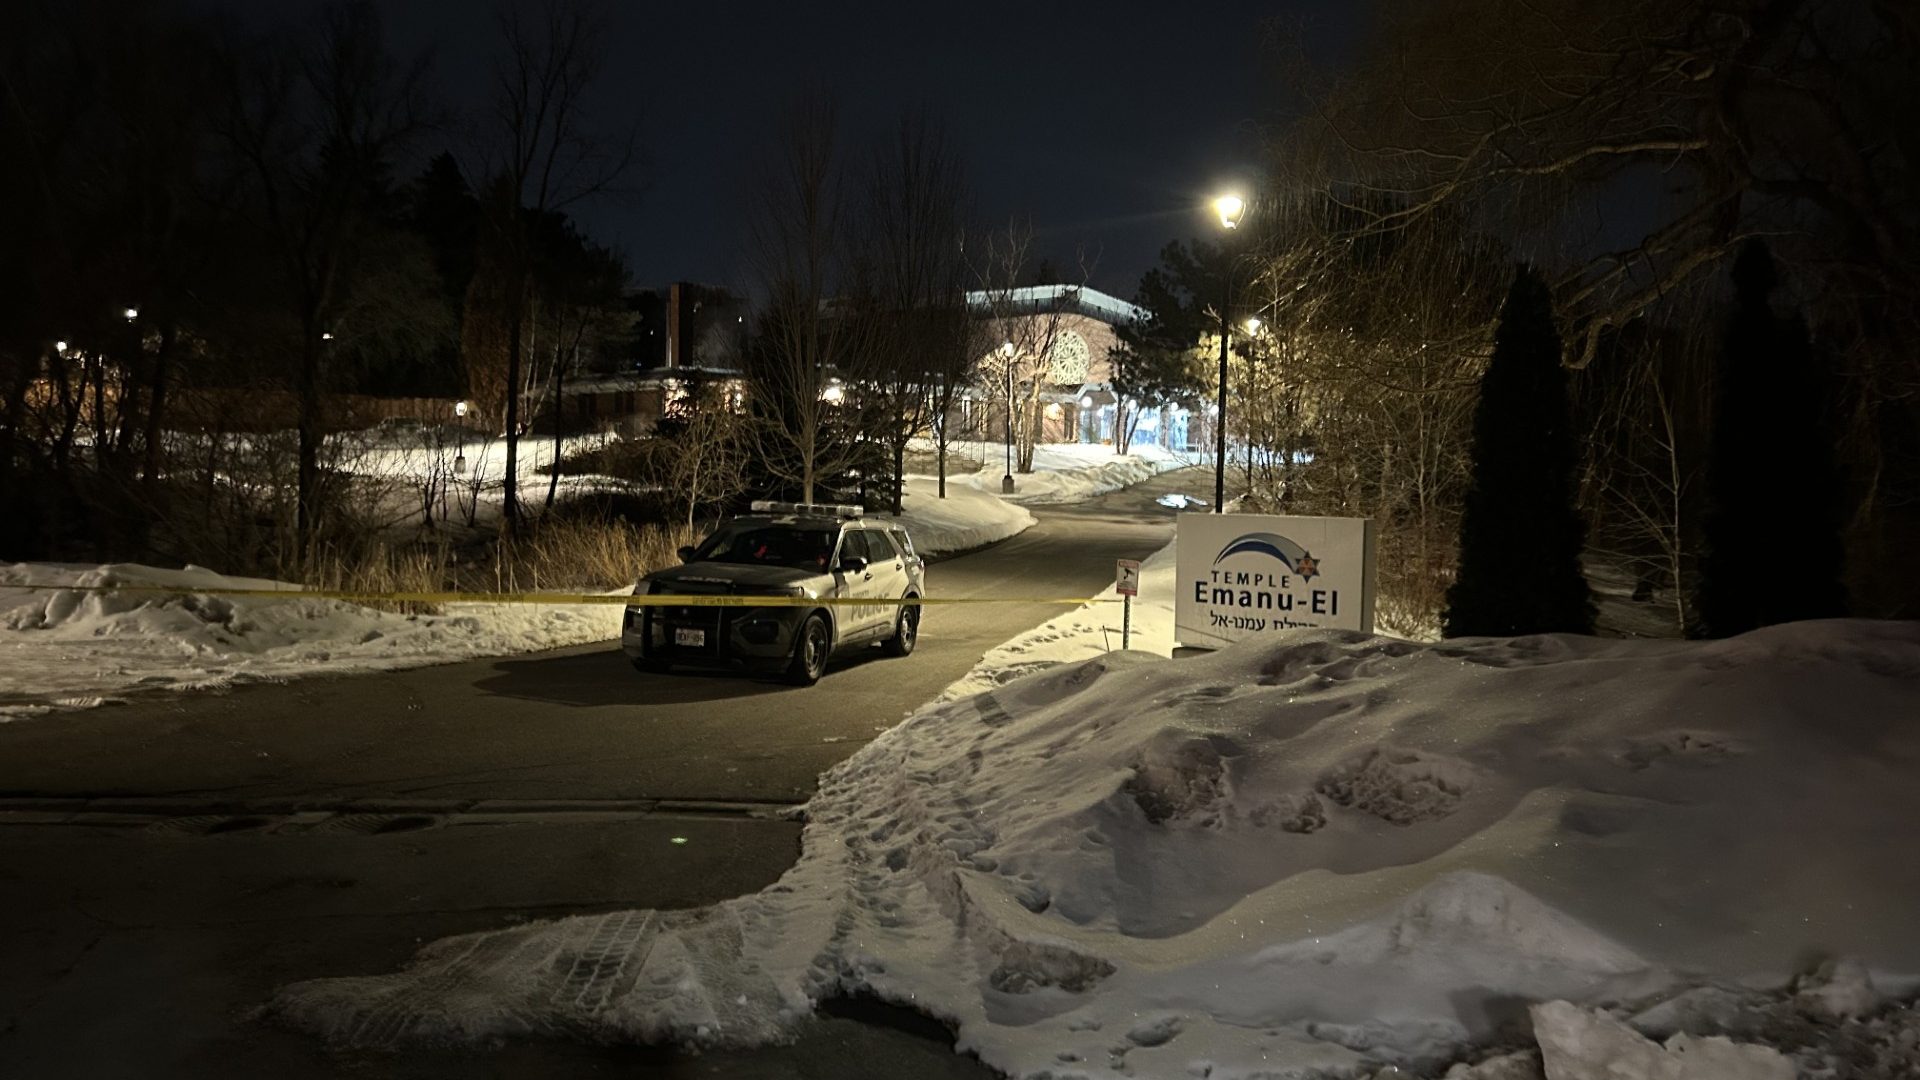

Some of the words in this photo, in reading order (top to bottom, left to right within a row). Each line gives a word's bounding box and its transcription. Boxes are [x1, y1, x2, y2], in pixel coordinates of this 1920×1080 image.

[1211, 570, 1291, 589] TEMPLE
[1195, 580, 1338, 616] Emanu-El
[1210, 609, 1266, 632] עמנו-אל
